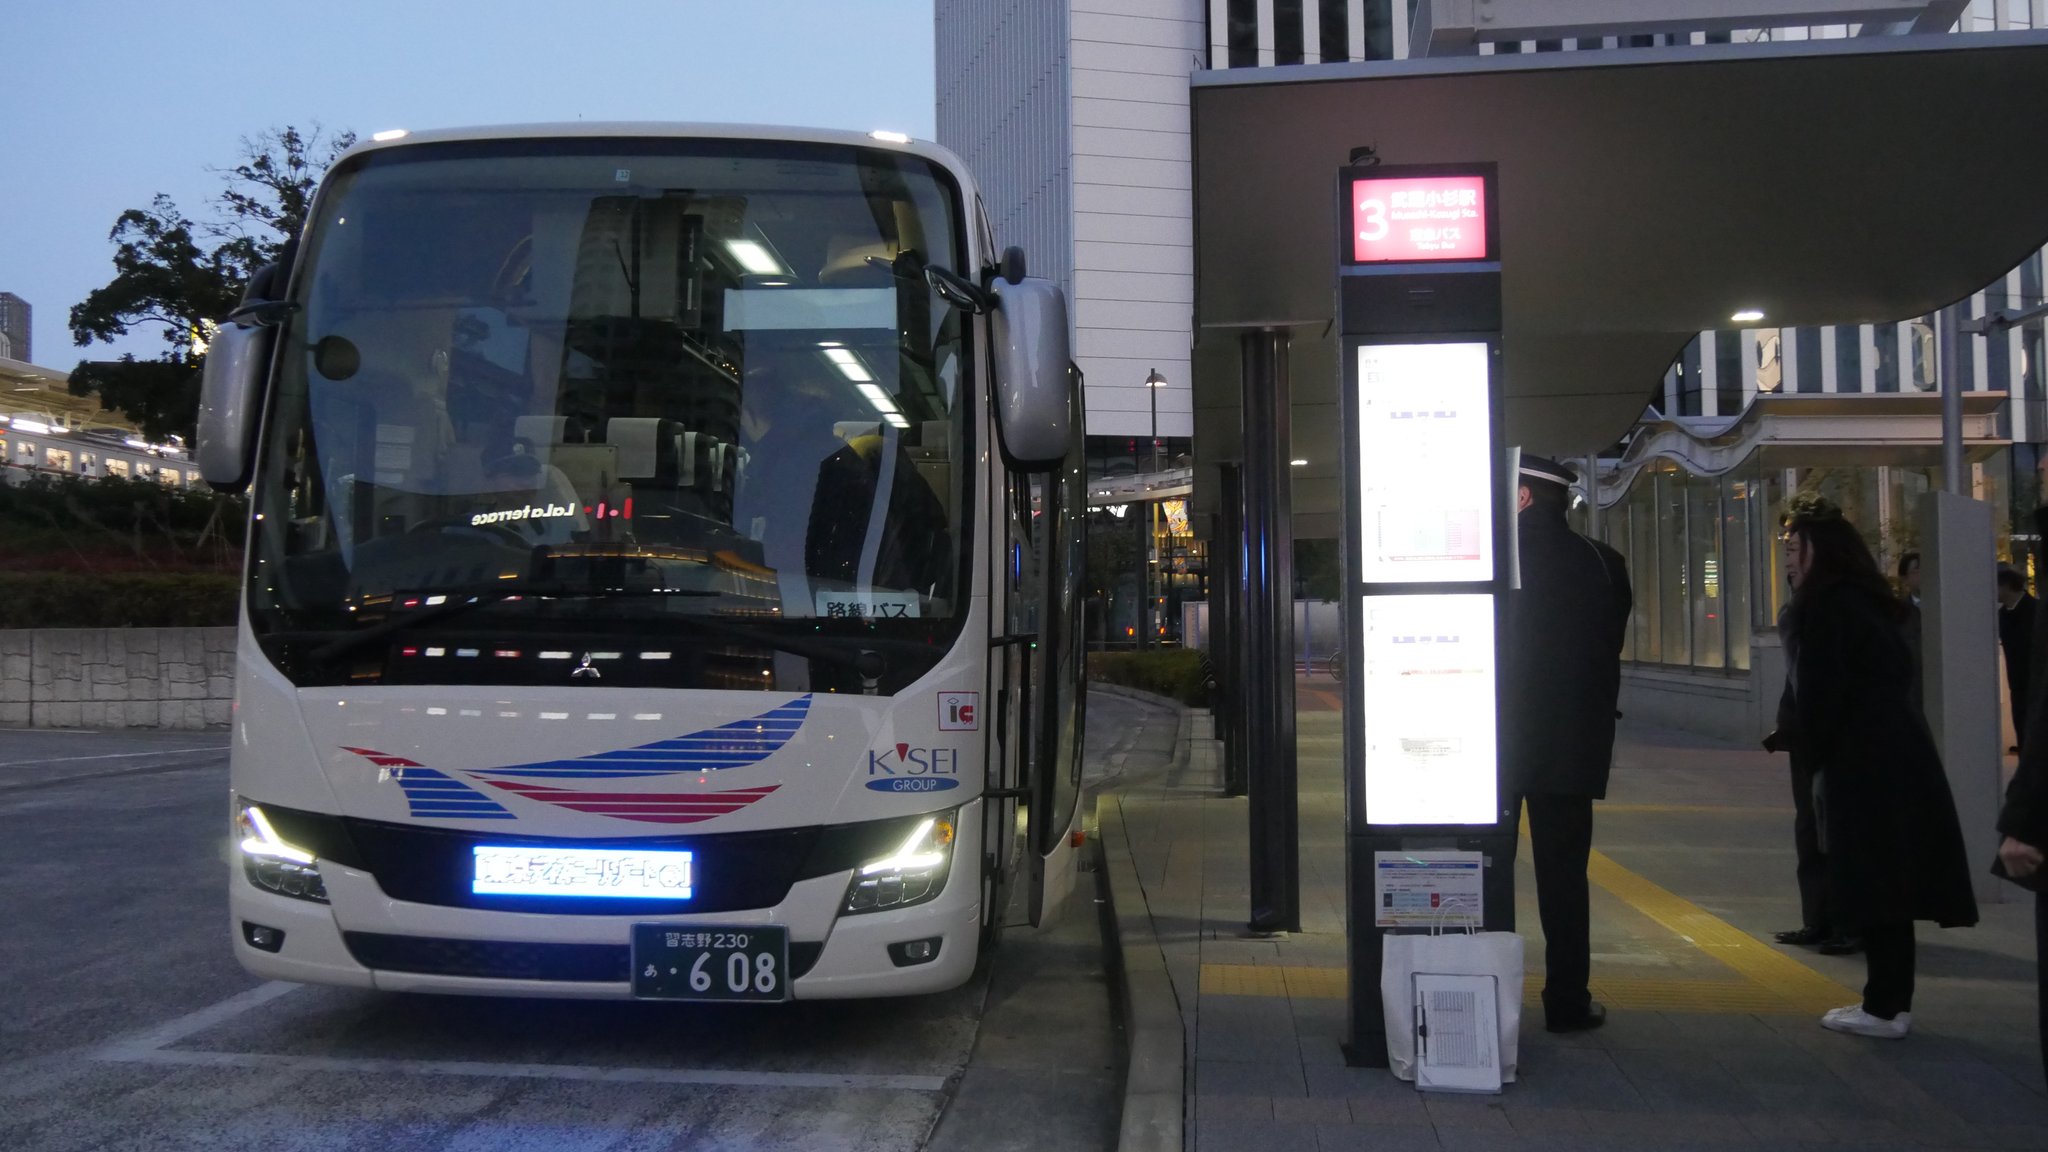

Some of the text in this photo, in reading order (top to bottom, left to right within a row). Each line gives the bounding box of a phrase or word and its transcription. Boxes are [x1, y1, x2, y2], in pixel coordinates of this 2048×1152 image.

[1391, 189, 1476, 208] 武小杉駅
[1359, 199, 1389, 241] 3
[1410, 227, 1461, 241] バス
[826, 602, 909, 618] 路線バス
[892, 779, 937, 791] GROUP
[644, 964, 658, 978] あ
